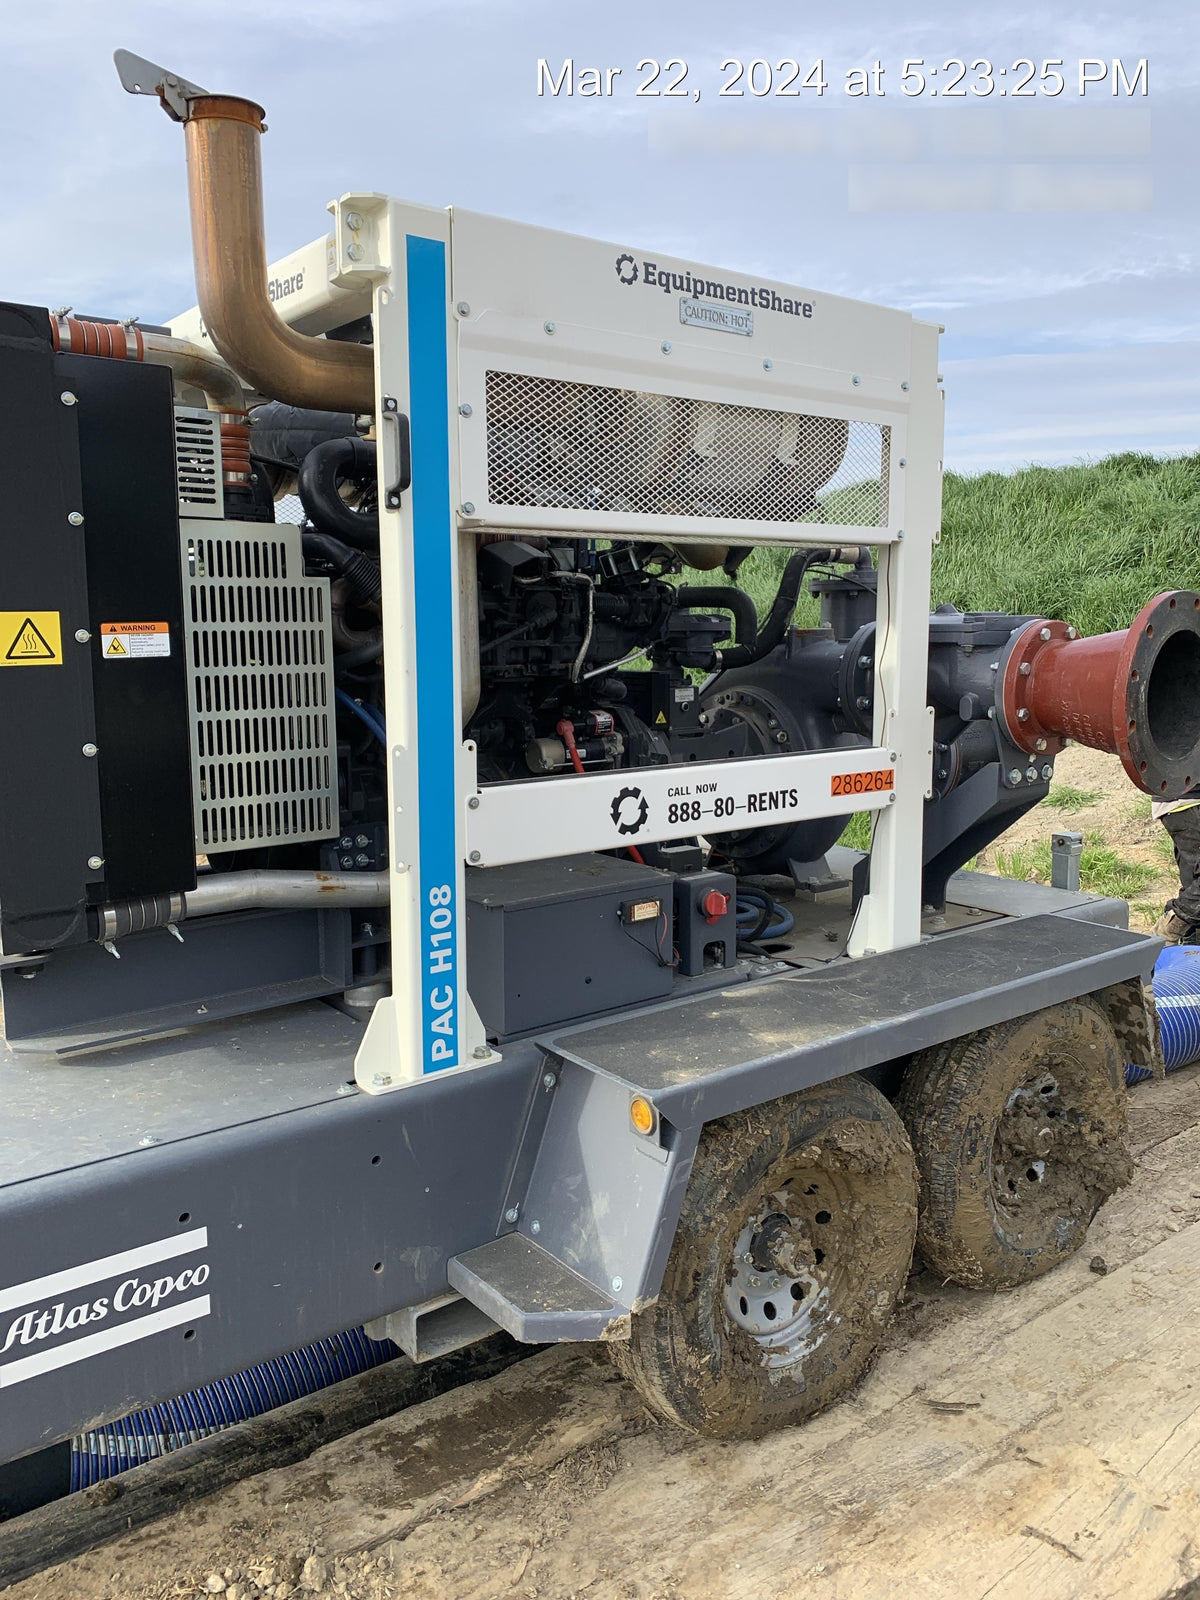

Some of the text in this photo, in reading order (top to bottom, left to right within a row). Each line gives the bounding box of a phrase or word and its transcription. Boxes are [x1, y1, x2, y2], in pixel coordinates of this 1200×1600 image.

[643, 262, 813, 319] EquipmentShare
[684, 305, 750, 329] CAUTION: HOT
[667, 783, 718, 797] CALL NOW
[832, 770, 893, 795] 286264
[429, 884, 454, 1062] PAC H108
[0, 1264, 210, 1353] Atlas Copco
